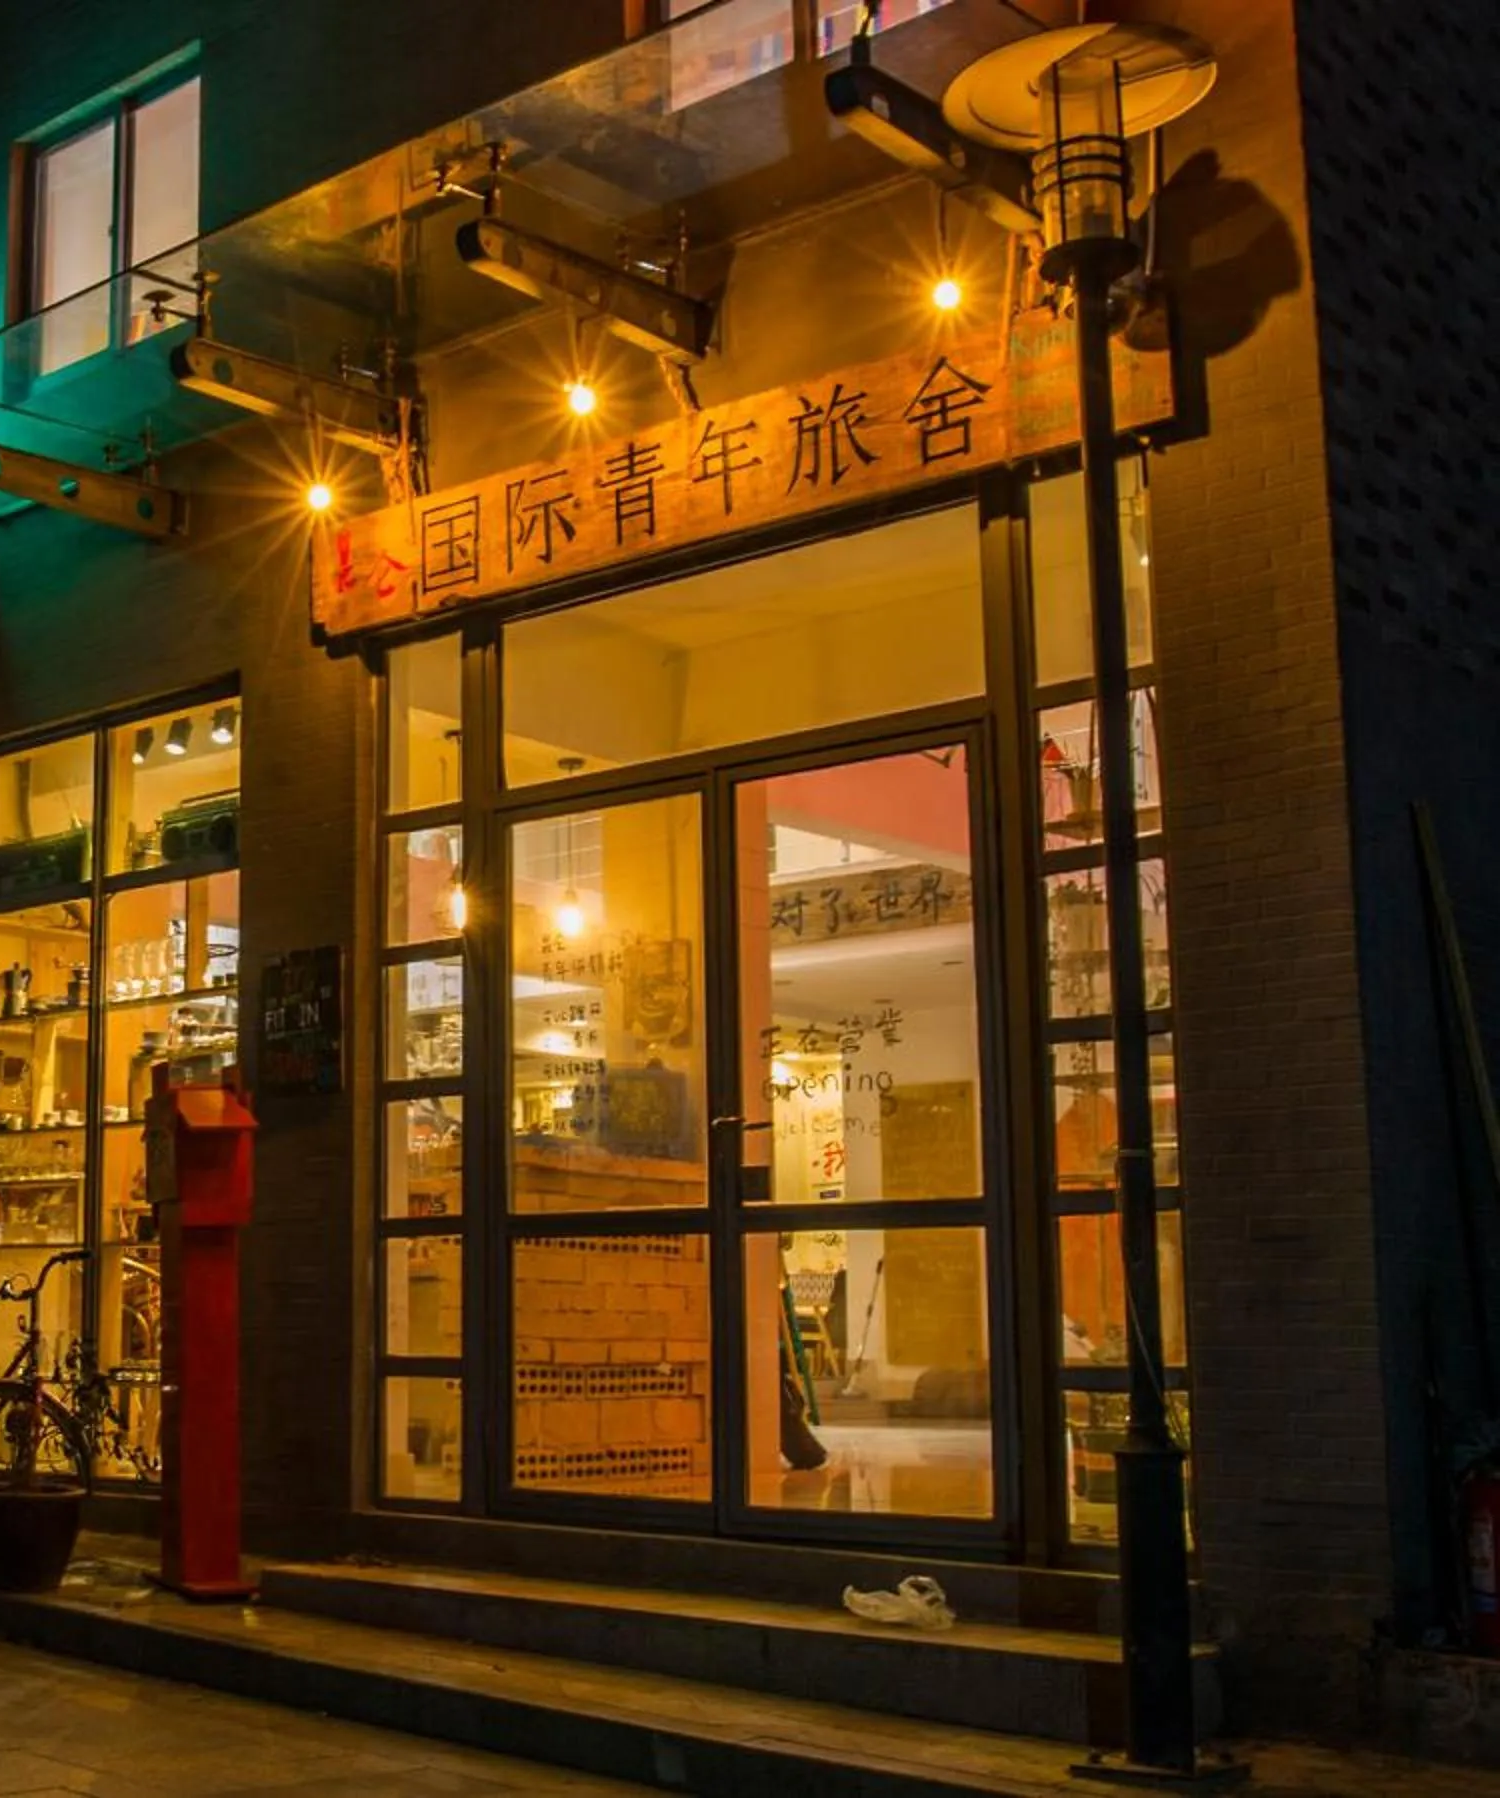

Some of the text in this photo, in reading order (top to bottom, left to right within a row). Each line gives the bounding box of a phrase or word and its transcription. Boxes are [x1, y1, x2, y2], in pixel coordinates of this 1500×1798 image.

[419, 355, 992, 596] 国际青年旅舍
